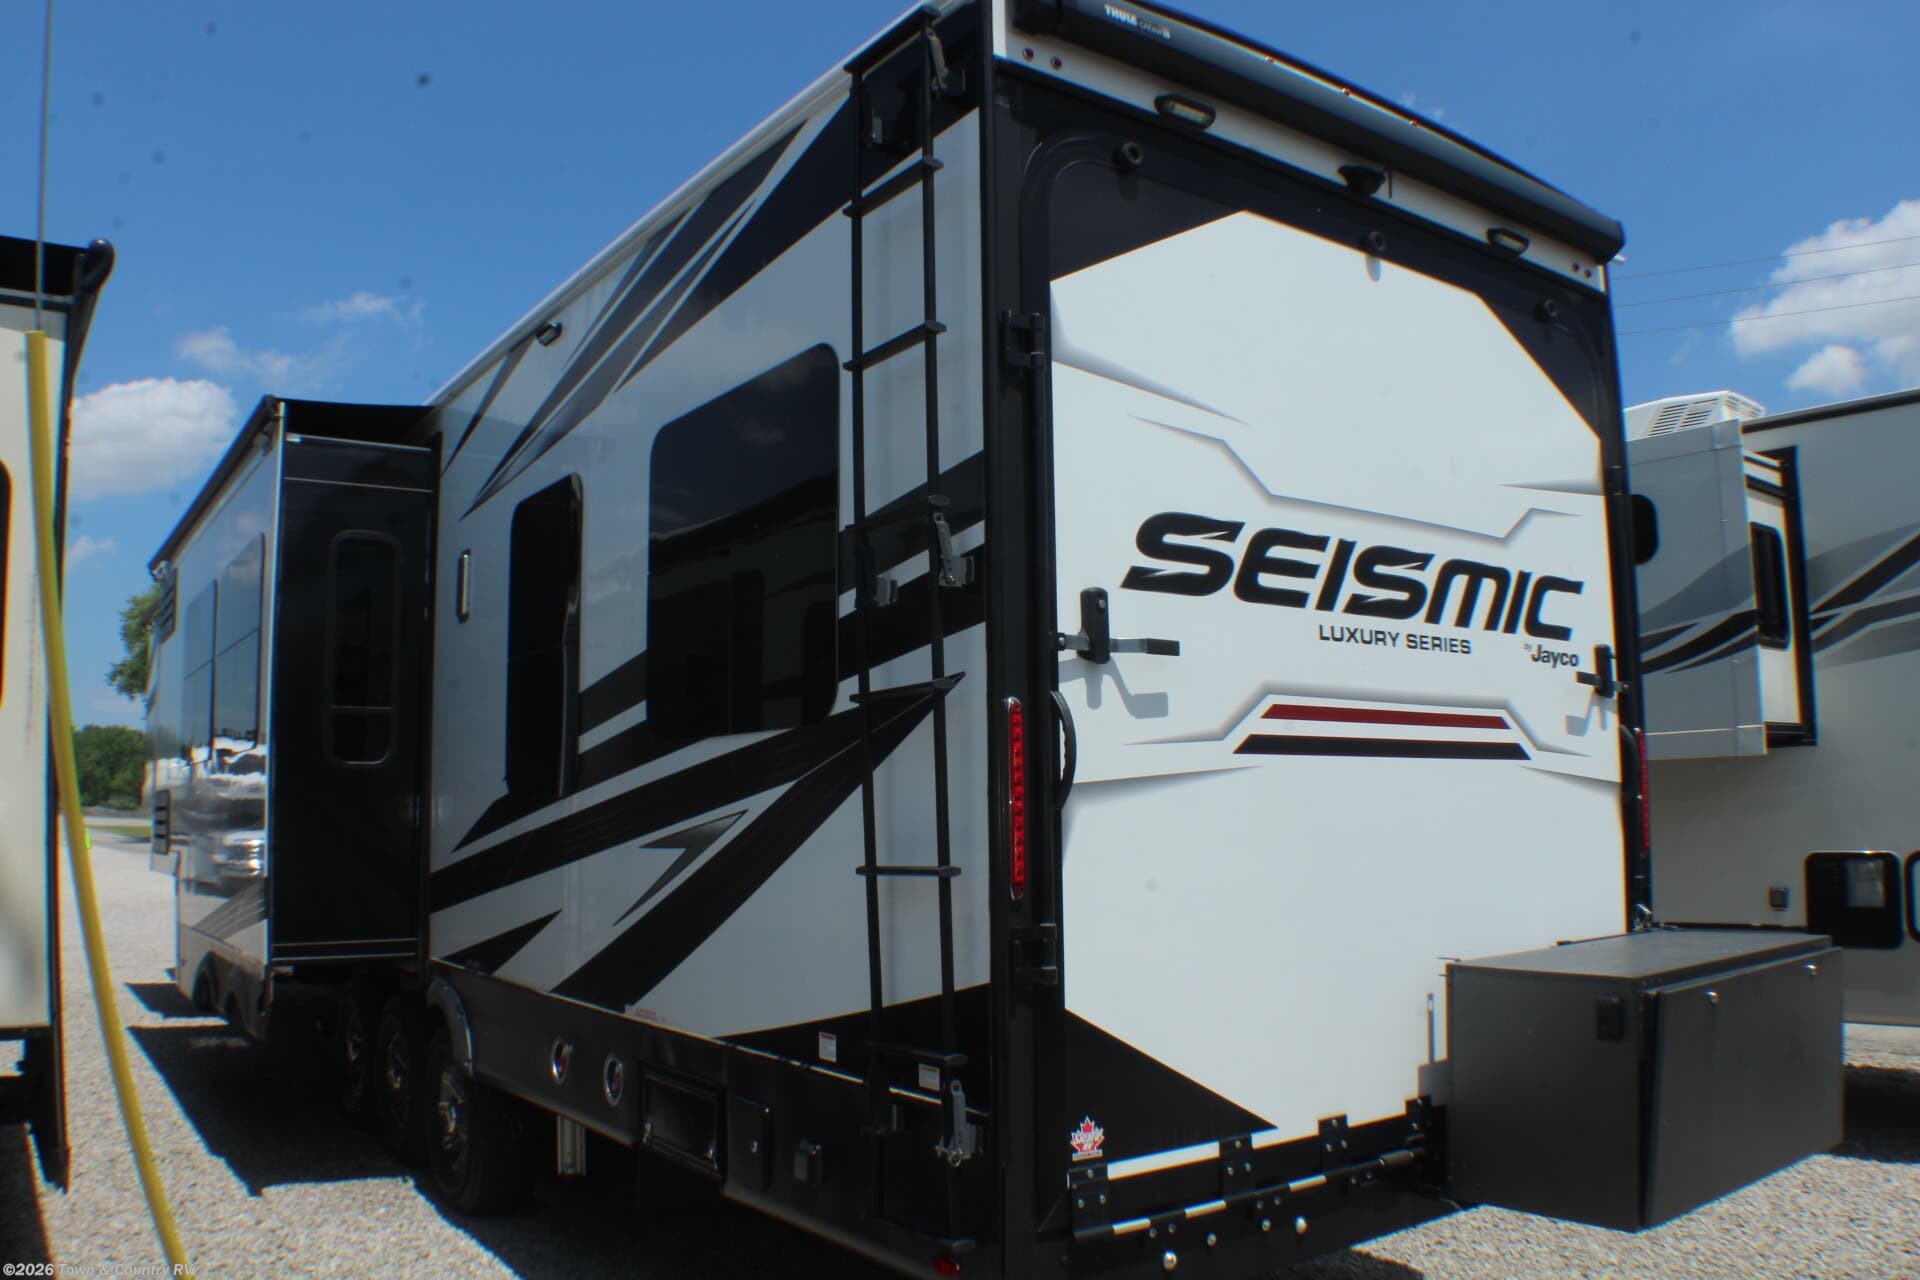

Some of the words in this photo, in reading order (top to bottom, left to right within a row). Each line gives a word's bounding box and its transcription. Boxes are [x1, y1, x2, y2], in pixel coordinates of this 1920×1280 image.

[1104, 4, 1137, 26] THULE
[1120, 511, 1584, 641] SEISMIC
[1319, 624, 1400, 648] LUXURY
[1406, 634, 1471, 654] SERIES
[1531, 644, 1579, 669] Jayco
